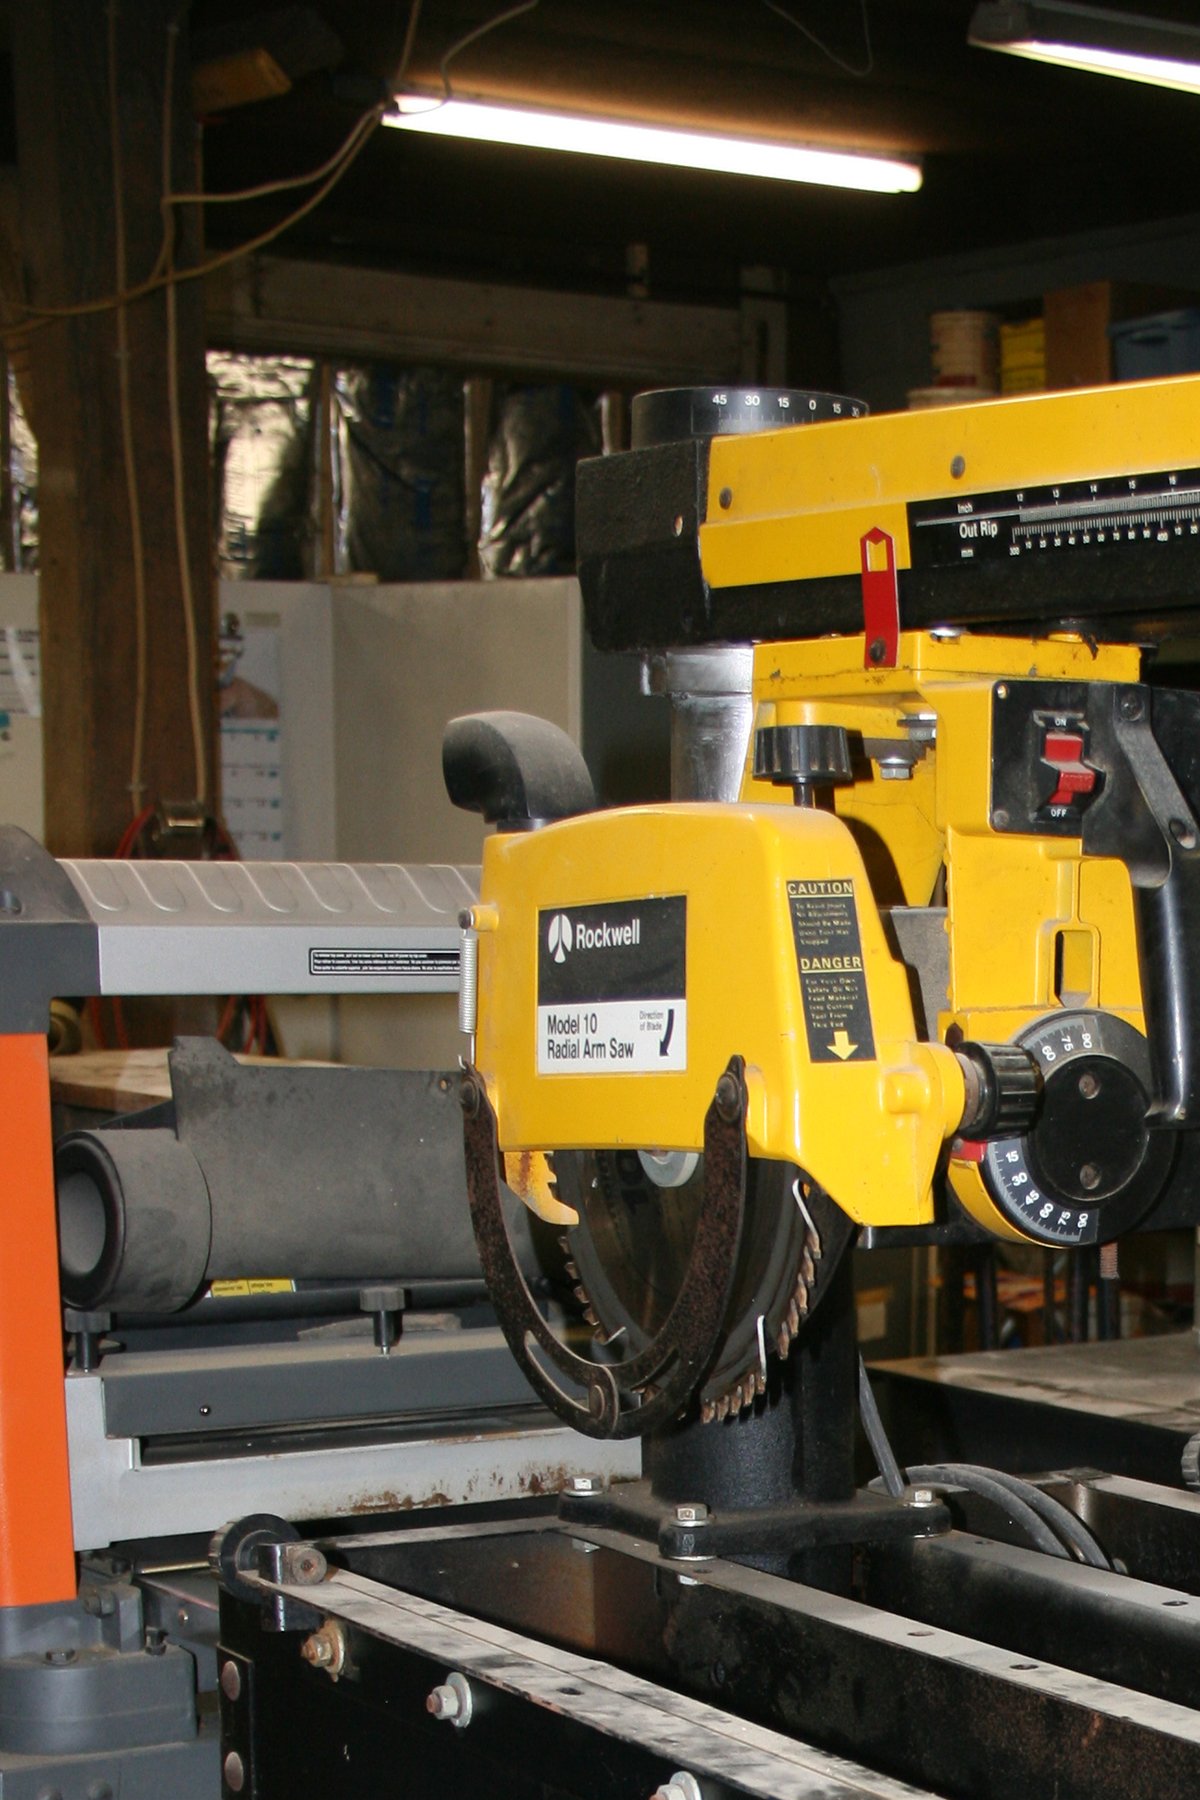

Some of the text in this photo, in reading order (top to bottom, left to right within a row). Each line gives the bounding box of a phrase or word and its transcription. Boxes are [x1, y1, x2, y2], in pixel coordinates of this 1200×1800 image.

[712, 394, 727, 405] 45
[745, 395, 760, 406] 30
[778, 397, 789, 408] 15
[808, 399, 817, 411] 0
[832, 403, 842, 414] 15
[1090, 484, 1098, 493] 14
[1128, 480, 1136, 489] 15
[957, 503, 973, 514] Inch
[959, 521, 998, 539] Out Rip
[1055, 718, 1067, 727] ON
[1050, 809, 1067, 817] OFF
[787, 882, 853, 895] CAUTION
[576, 918, 640, 950] Rockwell
[800, 956, 861, 970] DANGER
[639, 1010, 664, 1020] Direction
[547, 1013, 598, 1036] Model 10
[639, 1020, 662, 1031] of Blade
[547, 1038, 634, 1059] Radial Arm Saw
[1041, 1032, 1093, 1062] 60 75 90
[1005, 1150, 1089, 1229] 15 30 45 60 75 90
